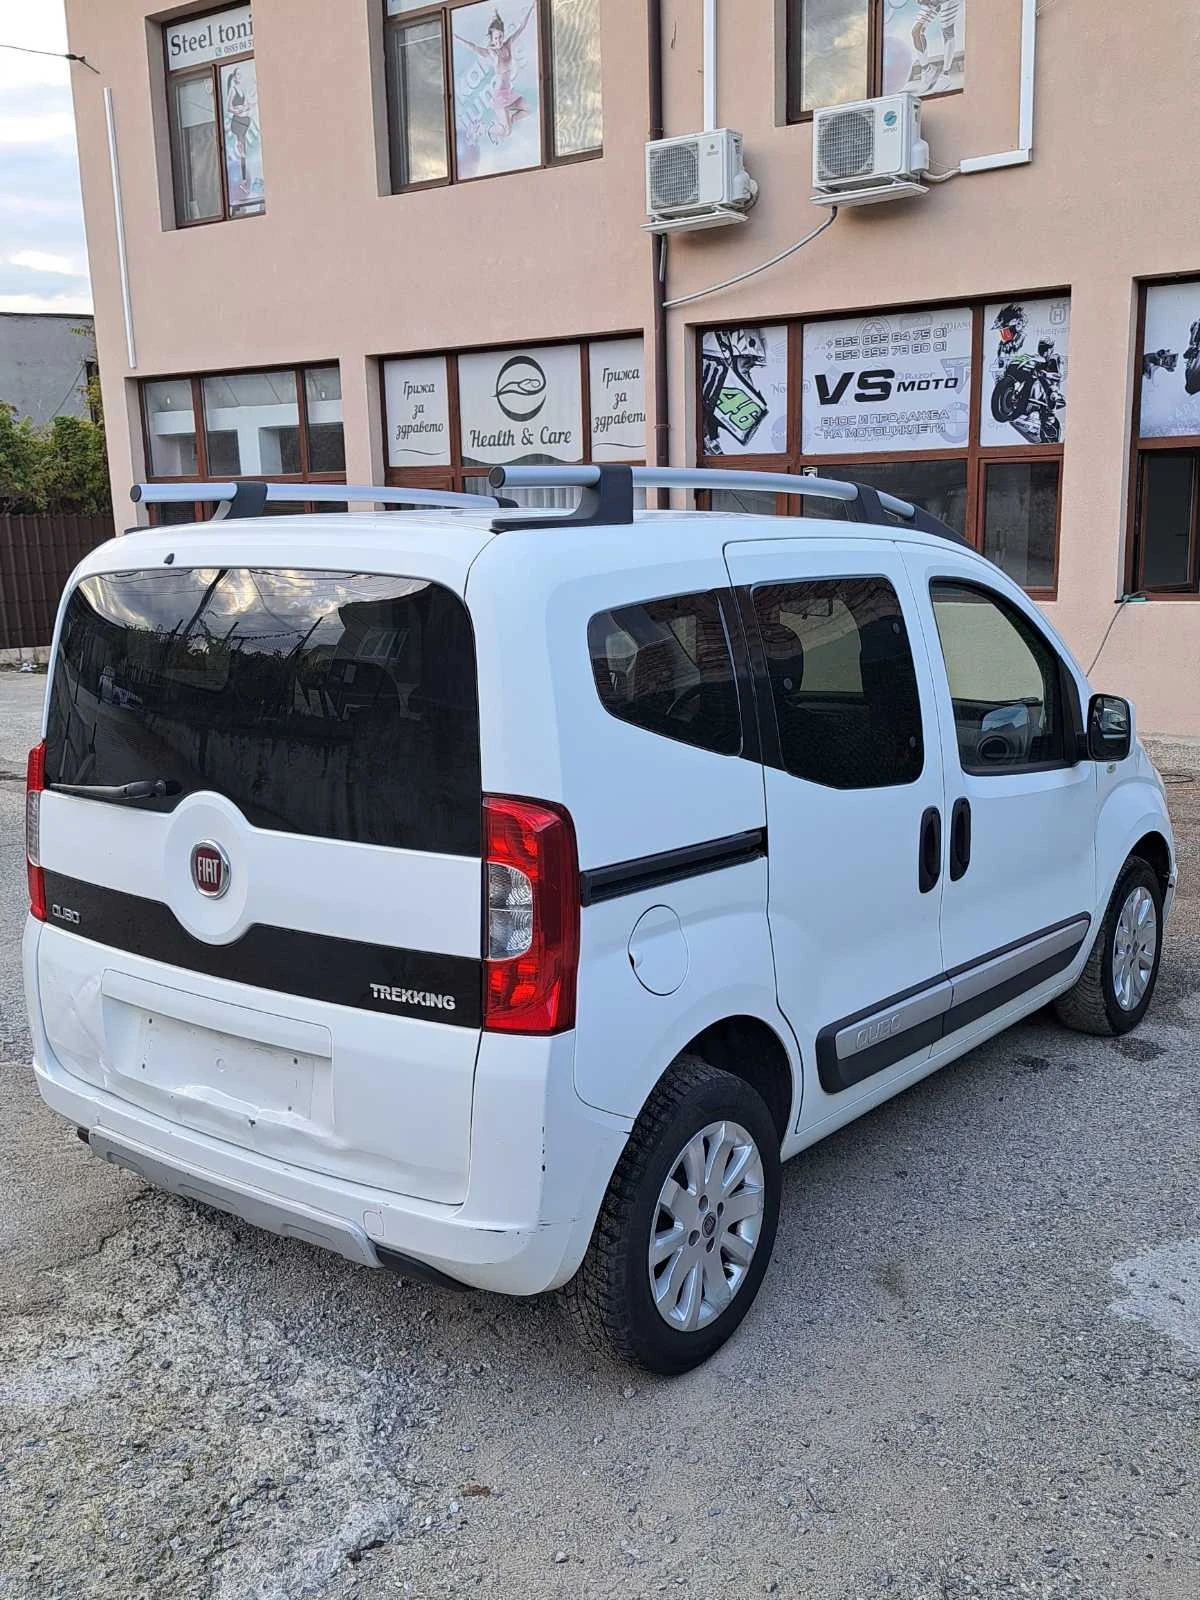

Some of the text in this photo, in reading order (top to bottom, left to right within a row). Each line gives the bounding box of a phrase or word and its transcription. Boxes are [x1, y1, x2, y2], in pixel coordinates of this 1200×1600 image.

[170, 14, 254, 56] Steel toni
[862, 333, 889, 345] 895
[912, 328, 931, 341] 75
[933, 327, 947, 339] 01
[862, 347, 889, 358] 899
[890, 344, 910, 356] 78
[911, 342, 931, 354] 80
[933, 341, 947, 352] 01
[603, 368, 640, 389] Грижа
[814, 369, 959, 405] VS MOTO
[403, 381, 435, 400] Грижа
[612, 391, 627, 410] за
[412, 403, 425, 419] за
[820, 409, 951, 426] ВНОС И ПРОДАЖБА
[396, 422, 444, 440] здравето
[469, 426, 572, 448] Health & Care
[823, 423, 946, 440] НА МОТОЦИКЛЕТИ
[196, 856, 220, 884] FIAT
[51, 904, 81, 924] QUBO
[369, 983, 456, 1010] TREKKING
[856, 1014, 901, 1050] QUBO
